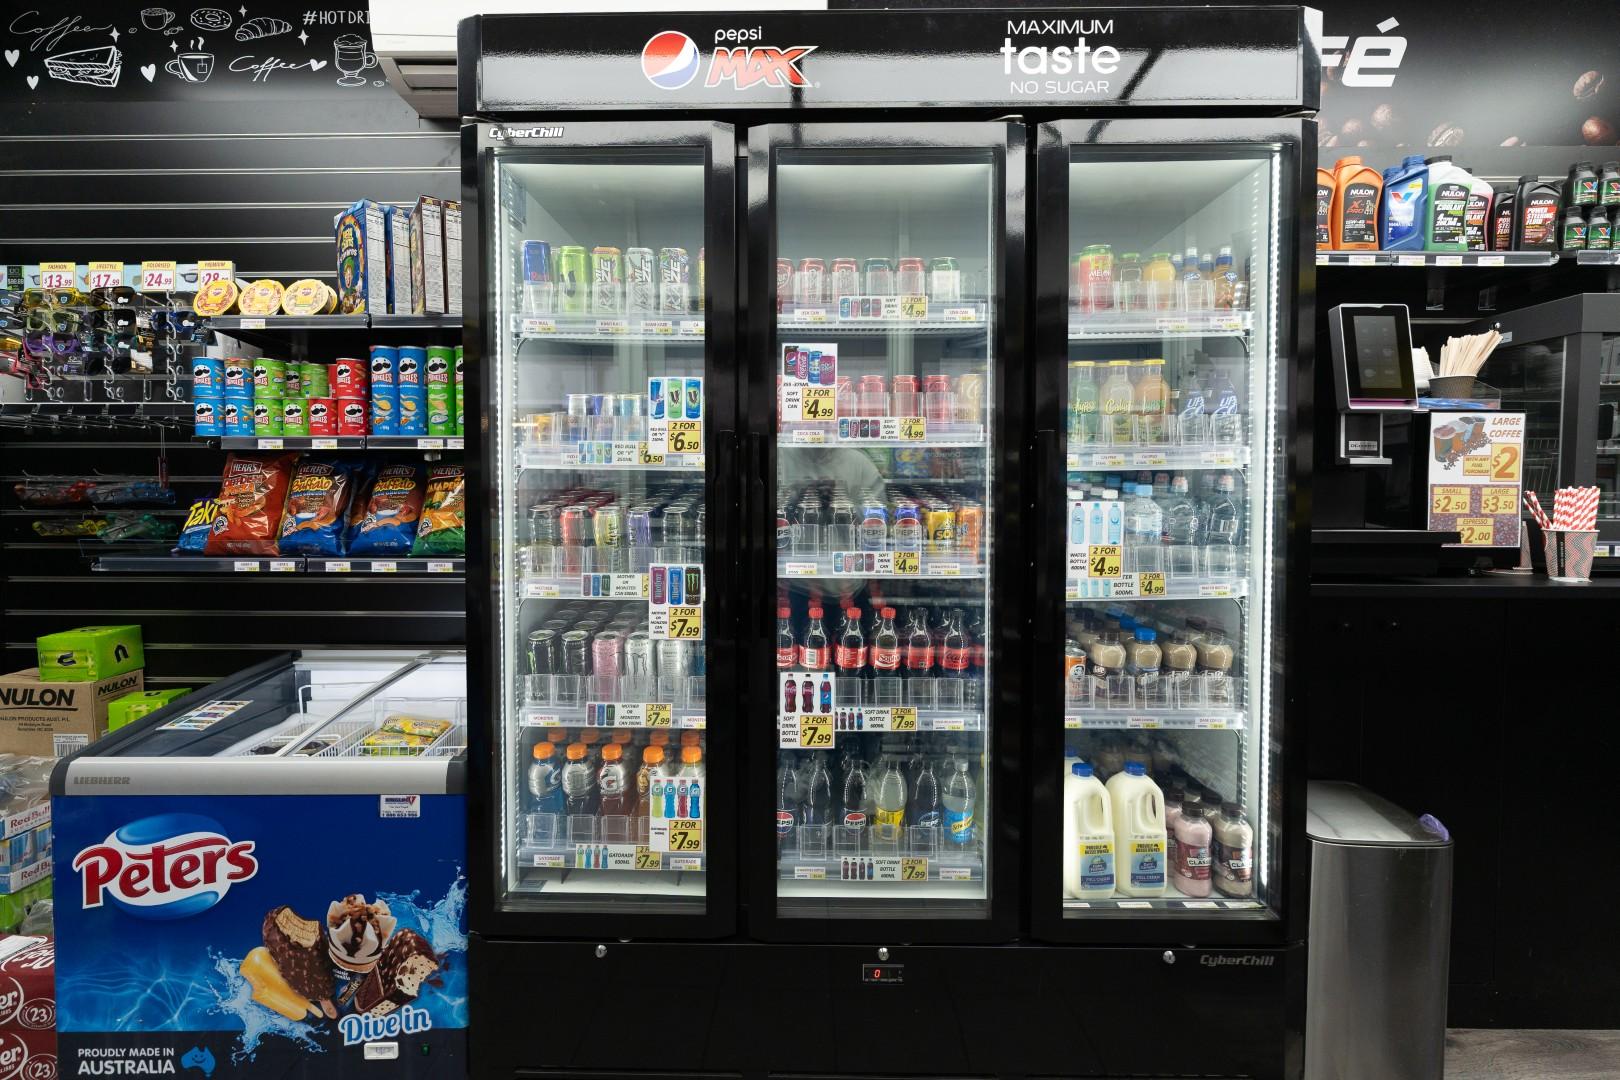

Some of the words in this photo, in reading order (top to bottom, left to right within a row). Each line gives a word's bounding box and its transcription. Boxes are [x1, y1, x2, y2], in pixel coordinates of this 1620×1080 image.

[9, 10, 112, 51] Coffee
[1007, 20, 1114, 34] MAXIMUM
[715, 26, 762, 44] pepsi
[1000, 37, 1121, 75] taste
[229, 55, 309, 82] Coffee
[704, 46, 818, 90] MAX
[1010, 81, 1039, 94] NO
[1045, 80, 1110, 94] SUGAR
[489, 127, 564, 141] CyberChill
[44, 274, 73, 288] $13.99
[92, 274, 120, 288] $17.99
[145, 273, 172, 287] $24.99
[902, 303, 926, 318] $4.99
[806, 389, 812, 397] 2
[814, 389, 830, 397] FOR
[804, 399, 834, 419] $4.99
[672, 422, 677, 430] 2
[679, 422, 696, 430] FOR
[1491, 417, 1521, 425] LARGE
[901, 424, 924, 440] $4.99
[1489, 430, 1522, 438] COFFEE
[669, 431, 699, 452] $6.50
[1492, 446, 1518, 479] $2
[1434, 495, 1467, 513] $2.50
[1482, 495, 1514, 513] $3.50
[1460, 526, 1490, 544] $2.00
[1093, 547, 1099, 555] 2
[1099, 547, 1117, 555] FOR
[895, 559, 919, 573] $4.99
[1090, 556, 1120, 577] $4.99
[1141, 580, 1164, 595] $4.99
[673, 608, 678, 616] 2
[680, 608, 696, 616] FOR
[670, 619, 700, 638] $7.99
[98, 676, 137, 696] NULON
[647, 711, 670, 726] $7.99
[804, 716, 810, 724] 2
[812, 716, 828, 724] FOR
[892, 715, 915, 730] $7.99
[802, 726, 832, 746] $7.99
[74, 776, 131, 785] LIEBHERR
[674, 821, 679, 829] 2
[680, 821, 697, 829] FOR
[670, 831, 700, 850] $7.99
[636, 854, 660, 868] $7.99
[73, 838, 258, 908] Peters
[903, 866, 926, 880] $7.99
[1200, 955, 1275, 967] CyberChill
[31, 1007, 48, 1023] 23
[339, 1013, 400, 1045] Dive
[402, 1005, 432, 1034] in
[78, 1048, 125, 1057] PROUDLY
[129, 1048, 161, 1057] MADE
[163, 1048, 175, 1057] IN
[34, 1062, 51, 1079] 23
[77, 1059, 176, 1075] AUSTRALIA
